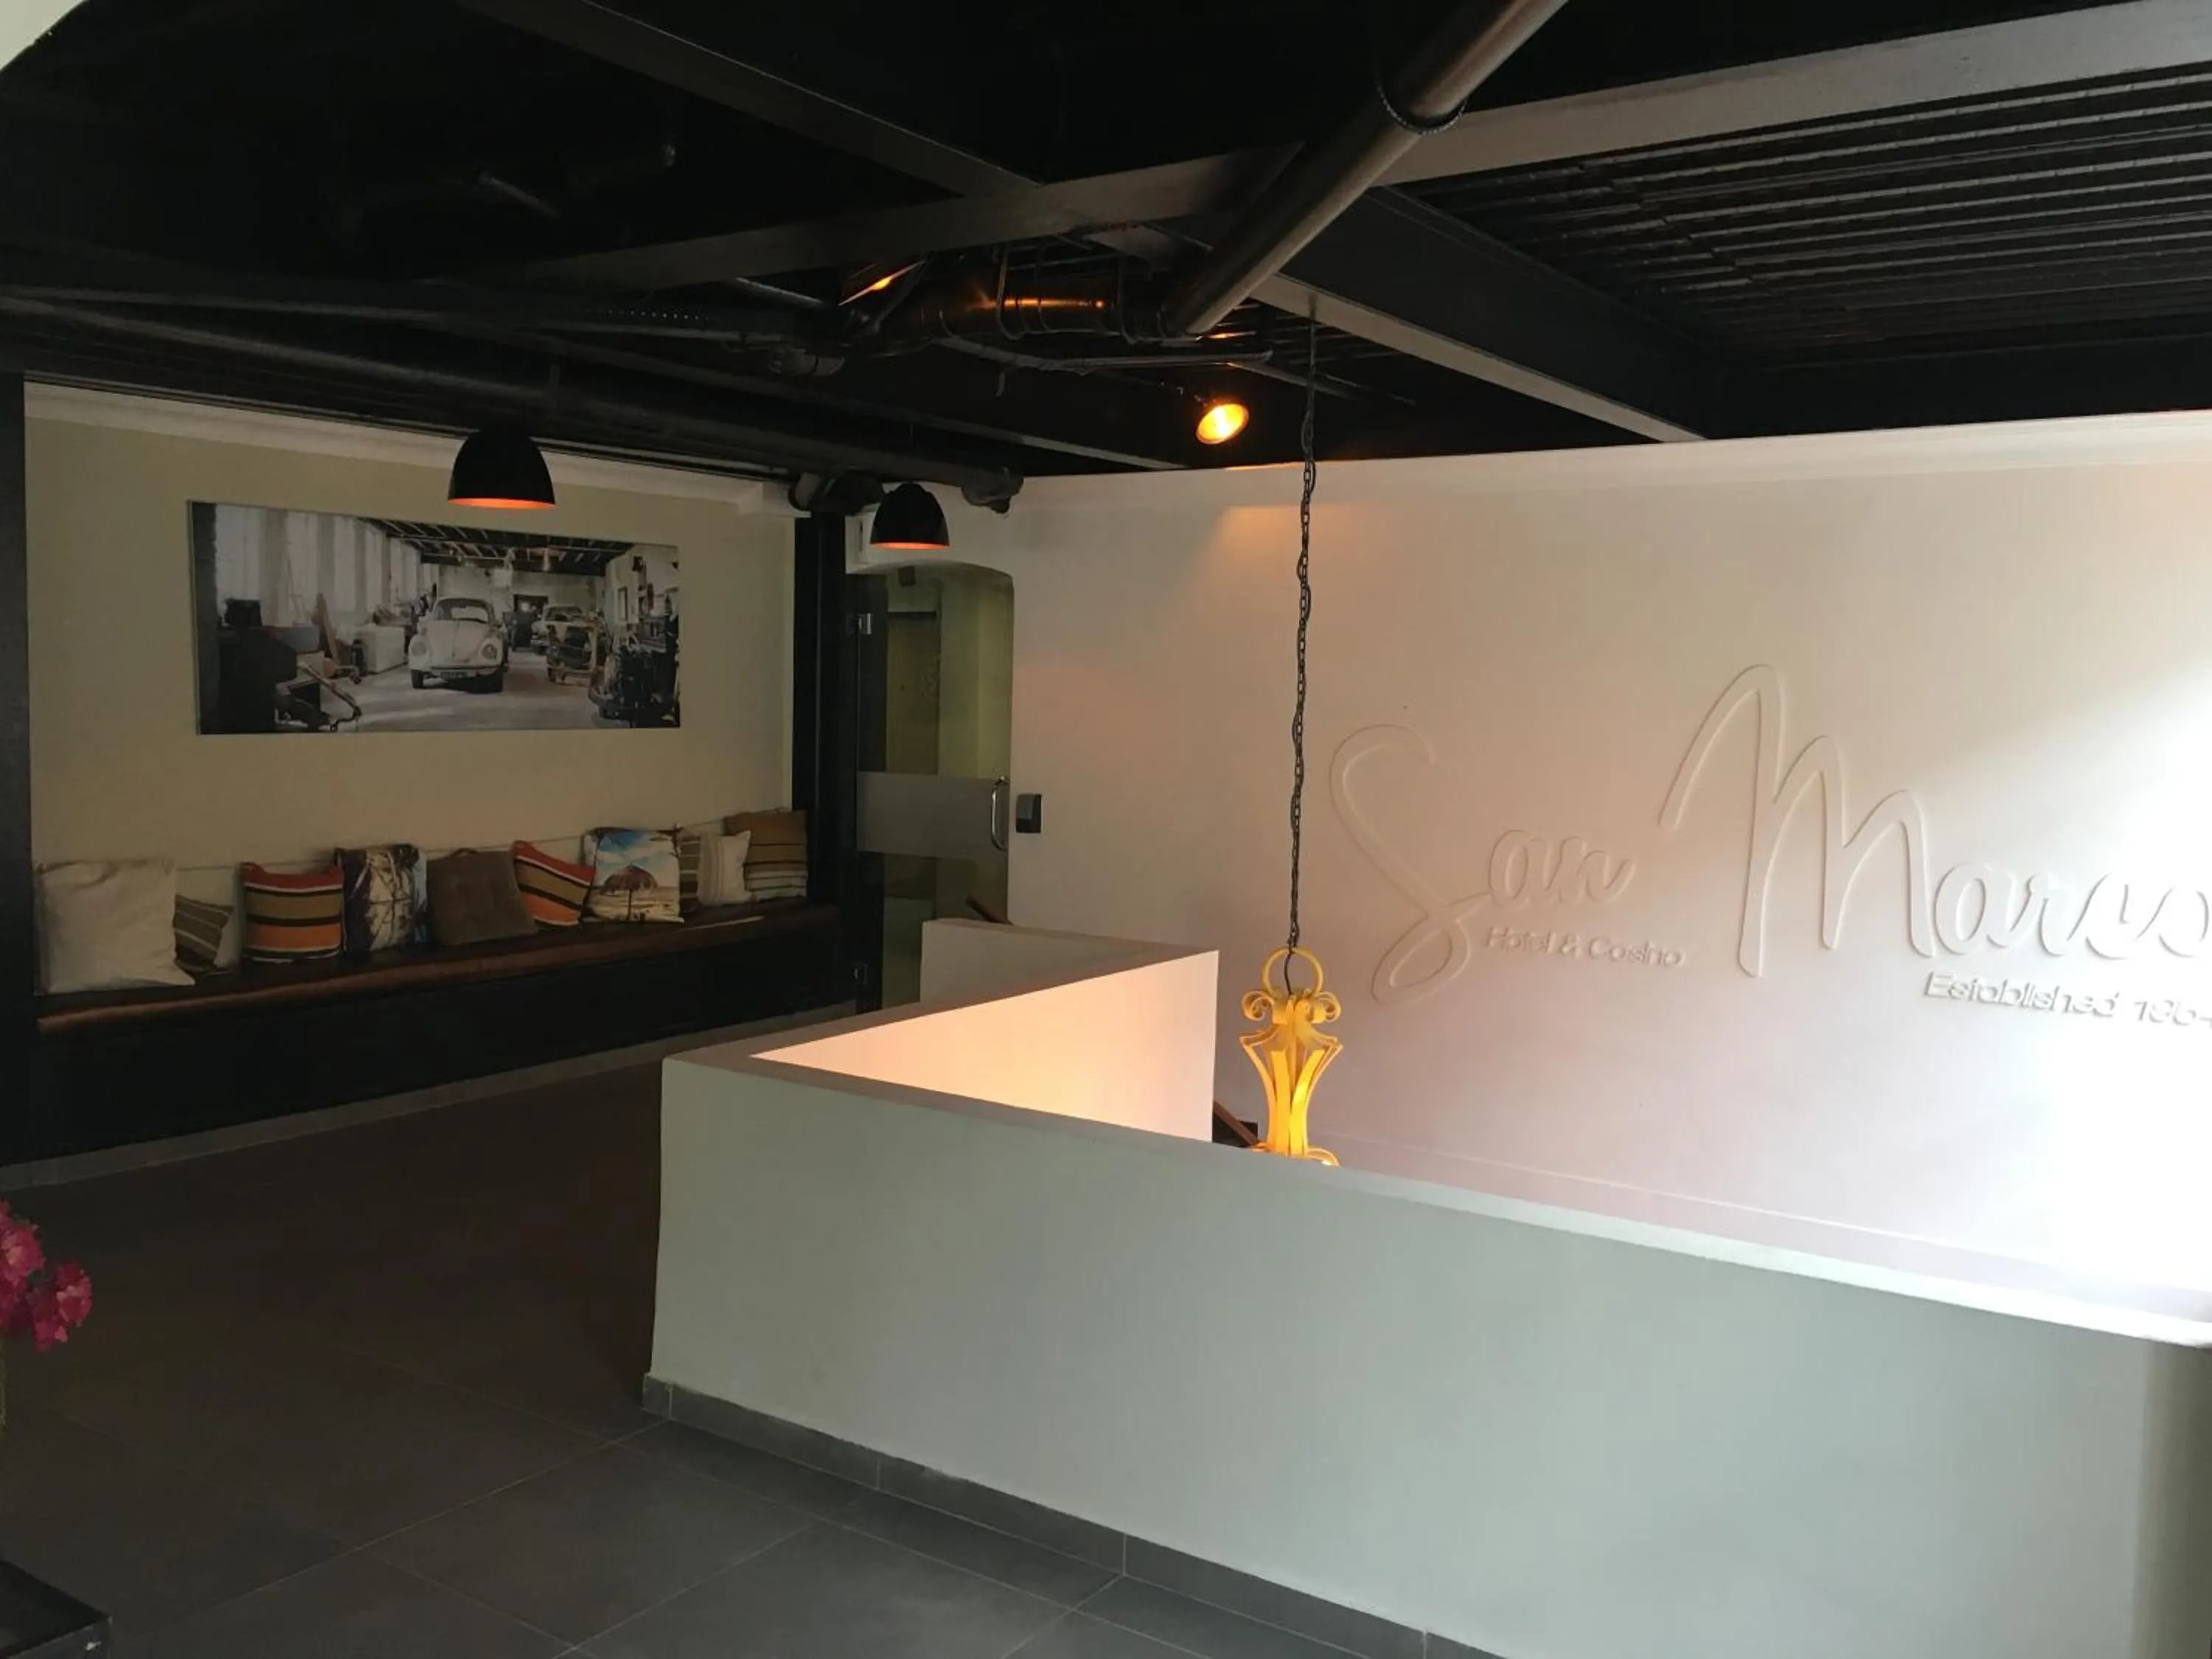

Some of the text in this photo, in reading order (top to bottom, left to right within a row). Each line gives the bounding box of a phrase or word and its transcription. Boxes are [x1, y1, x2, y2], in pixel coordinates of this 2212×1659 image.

[1329, 663, 2212, 1004] San Marco
[1486, 925, 1686, 967] Hotel & Casino
[1923, 970, 2121, 1019] Established
